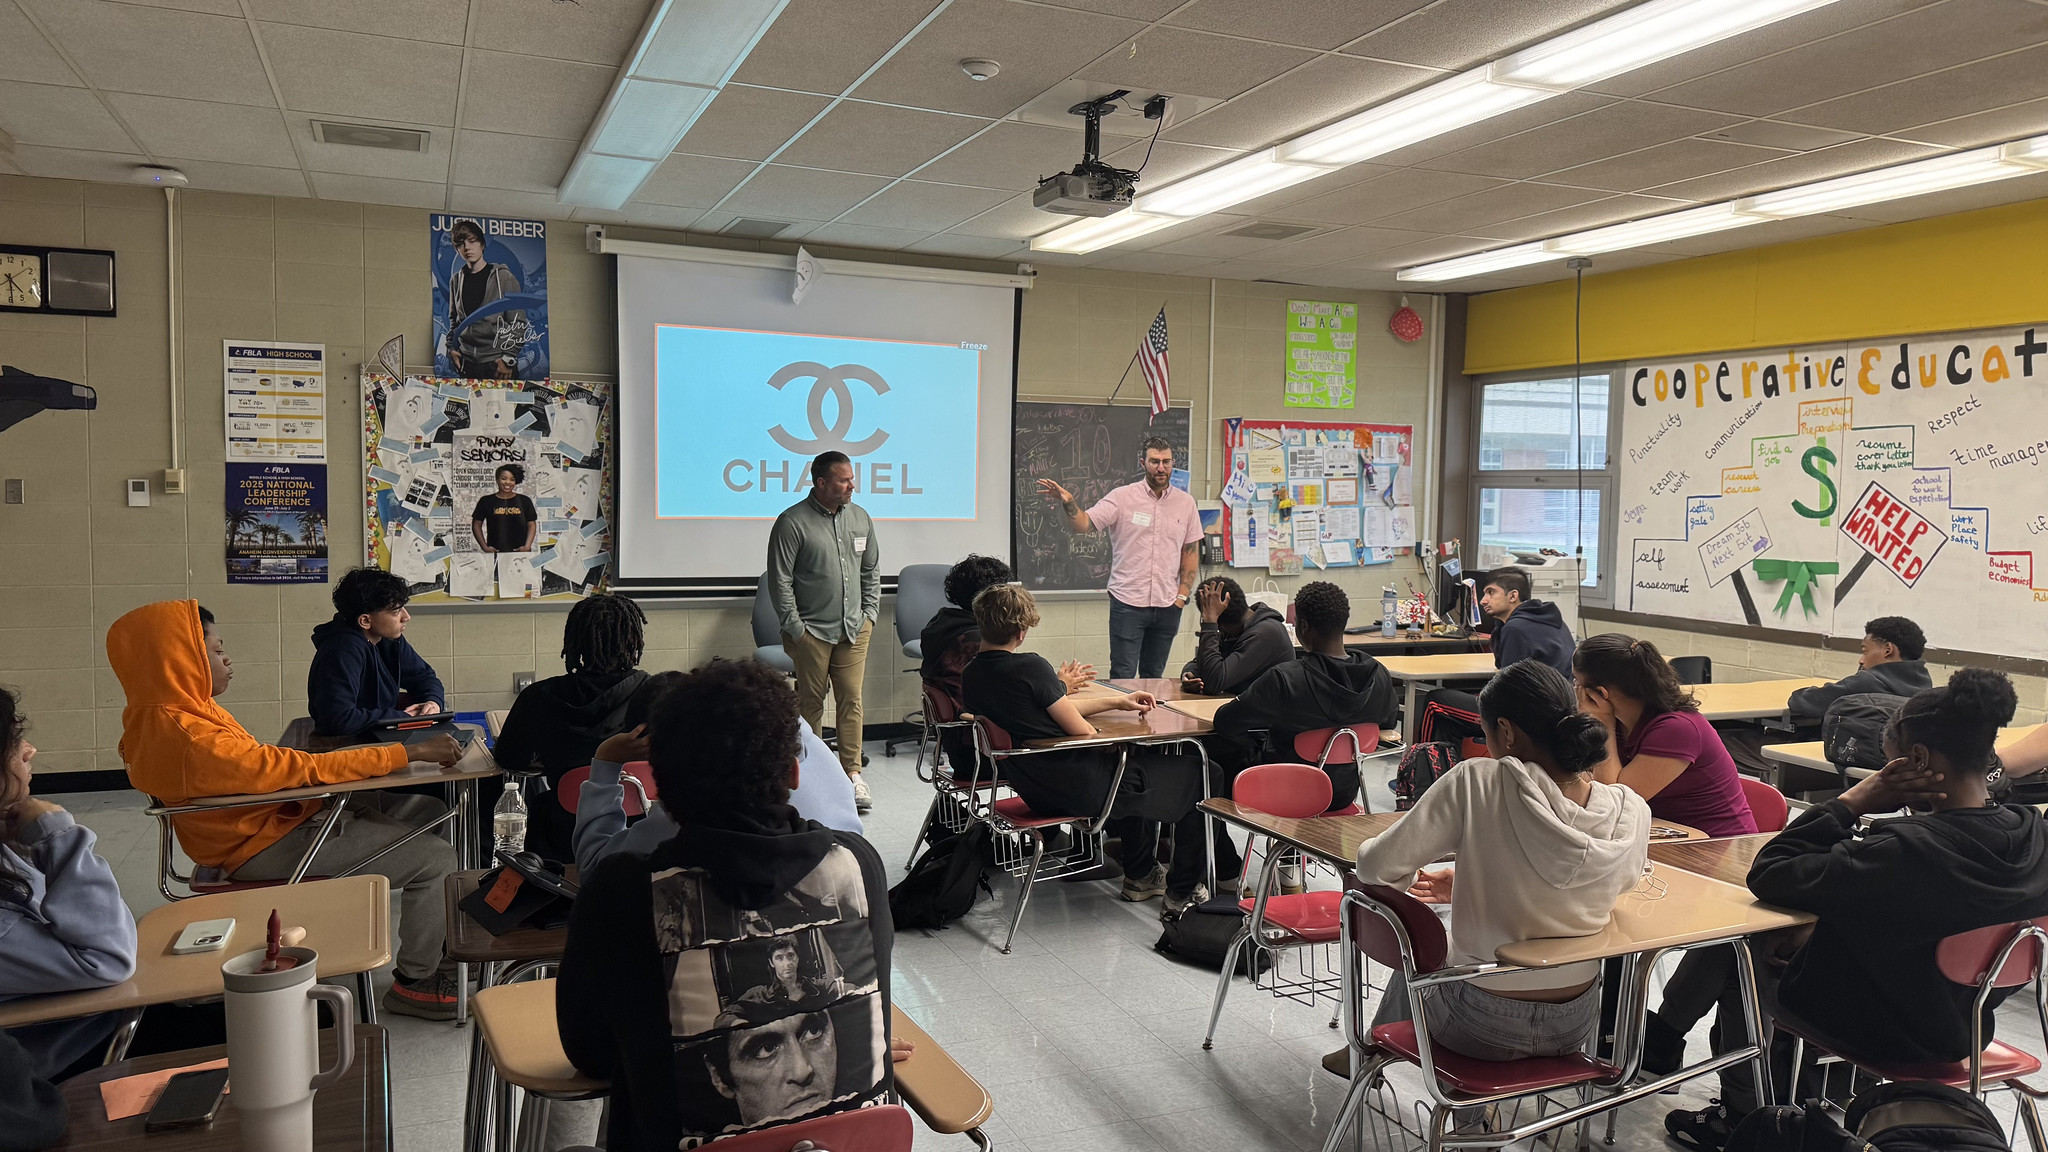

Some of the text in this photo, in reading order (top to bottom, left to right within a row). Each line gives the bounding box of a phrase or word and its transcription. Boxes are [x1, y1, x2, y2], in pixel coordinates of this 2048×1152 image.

[432, 216, 545, 239] JUN BIEBER
[242, 349, 262, 357] FBLA
[285, 351, 314, 359] SCHOOL
[961, 341, 988, 351] Freeze
[1927, 393, 1982, 434] Respect
[1629, 413, 1682, 464] Punctuality
[1856, 440, 1906, 450] resume
[460, 448, 527, 462] SENIORS!
[1757, 441, 1793, 457] find a
[1857, 452, 1884, 461] cover
[1854, 461, 1881, 470] thank
[1881, 463, 1897, 472] you
[266, 481, 315, 489] NATIONAL
[723, 459, 923, 495] CHAEL
[1232, 472, 1246, 488] Hi
[1650, 470, 1678, 496] team
[1911, 475, 1943, 485] school
[248, 489, 308, 497] LEADERSHIP
[1912, 485, 1943, 493] to work
[244, 497, 311, 506] CONFERENCE
[1689, 500, 1715, 520] setting
[1864, 489, 1929, 546] HELP
[1705, 520, 1751, 555] Dream Job
[1845, 507, 1923, 580] WANTED
[1635, 548, 1666, 571] self
[1712, 534, 1755, 569] Next Exit
[1989, 557, 2021, 574] Budget
